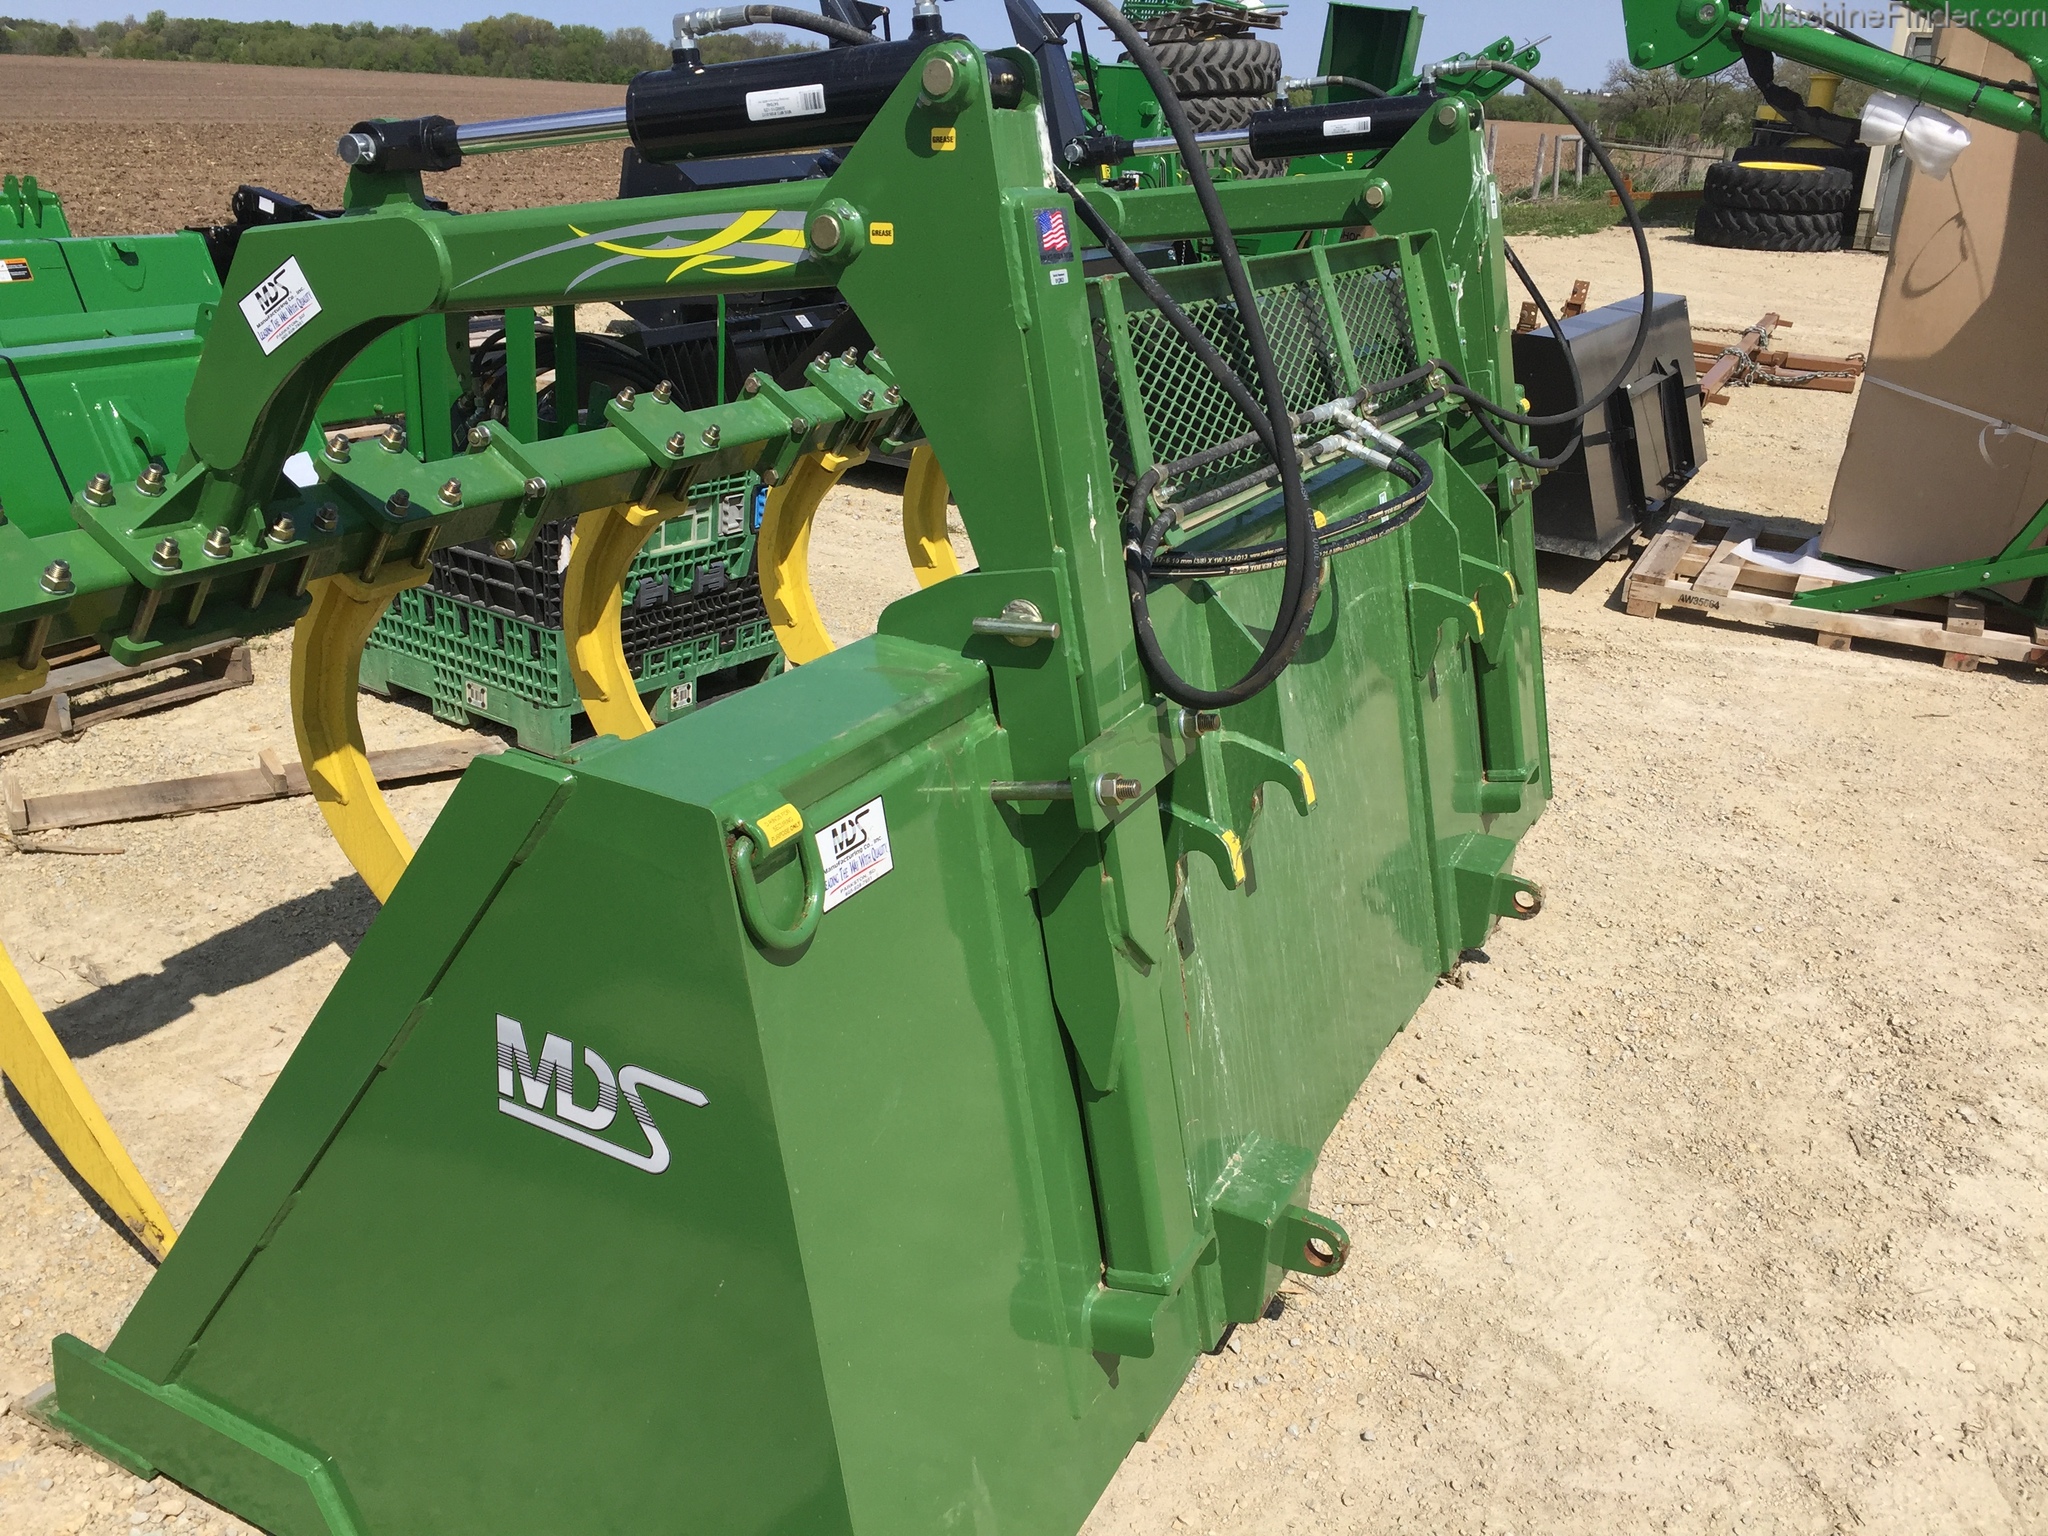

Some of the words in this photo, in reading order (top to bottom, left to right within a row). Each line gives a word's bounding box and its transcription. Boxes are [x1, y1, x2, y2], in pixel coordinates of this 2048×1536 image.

[932, 135, 954, 143] GREASE
[871, 229, 892, 237] GREASE
[255, 268, 290, 315] MDS
[256, 301, 289, 329] Manufacturing
[789, 821, 801, 832] ONLY
[831, 808, 870, 860] MDS
[825, 875, 839, 891] EADING
[496, 1012, 710, 1175] MDS
